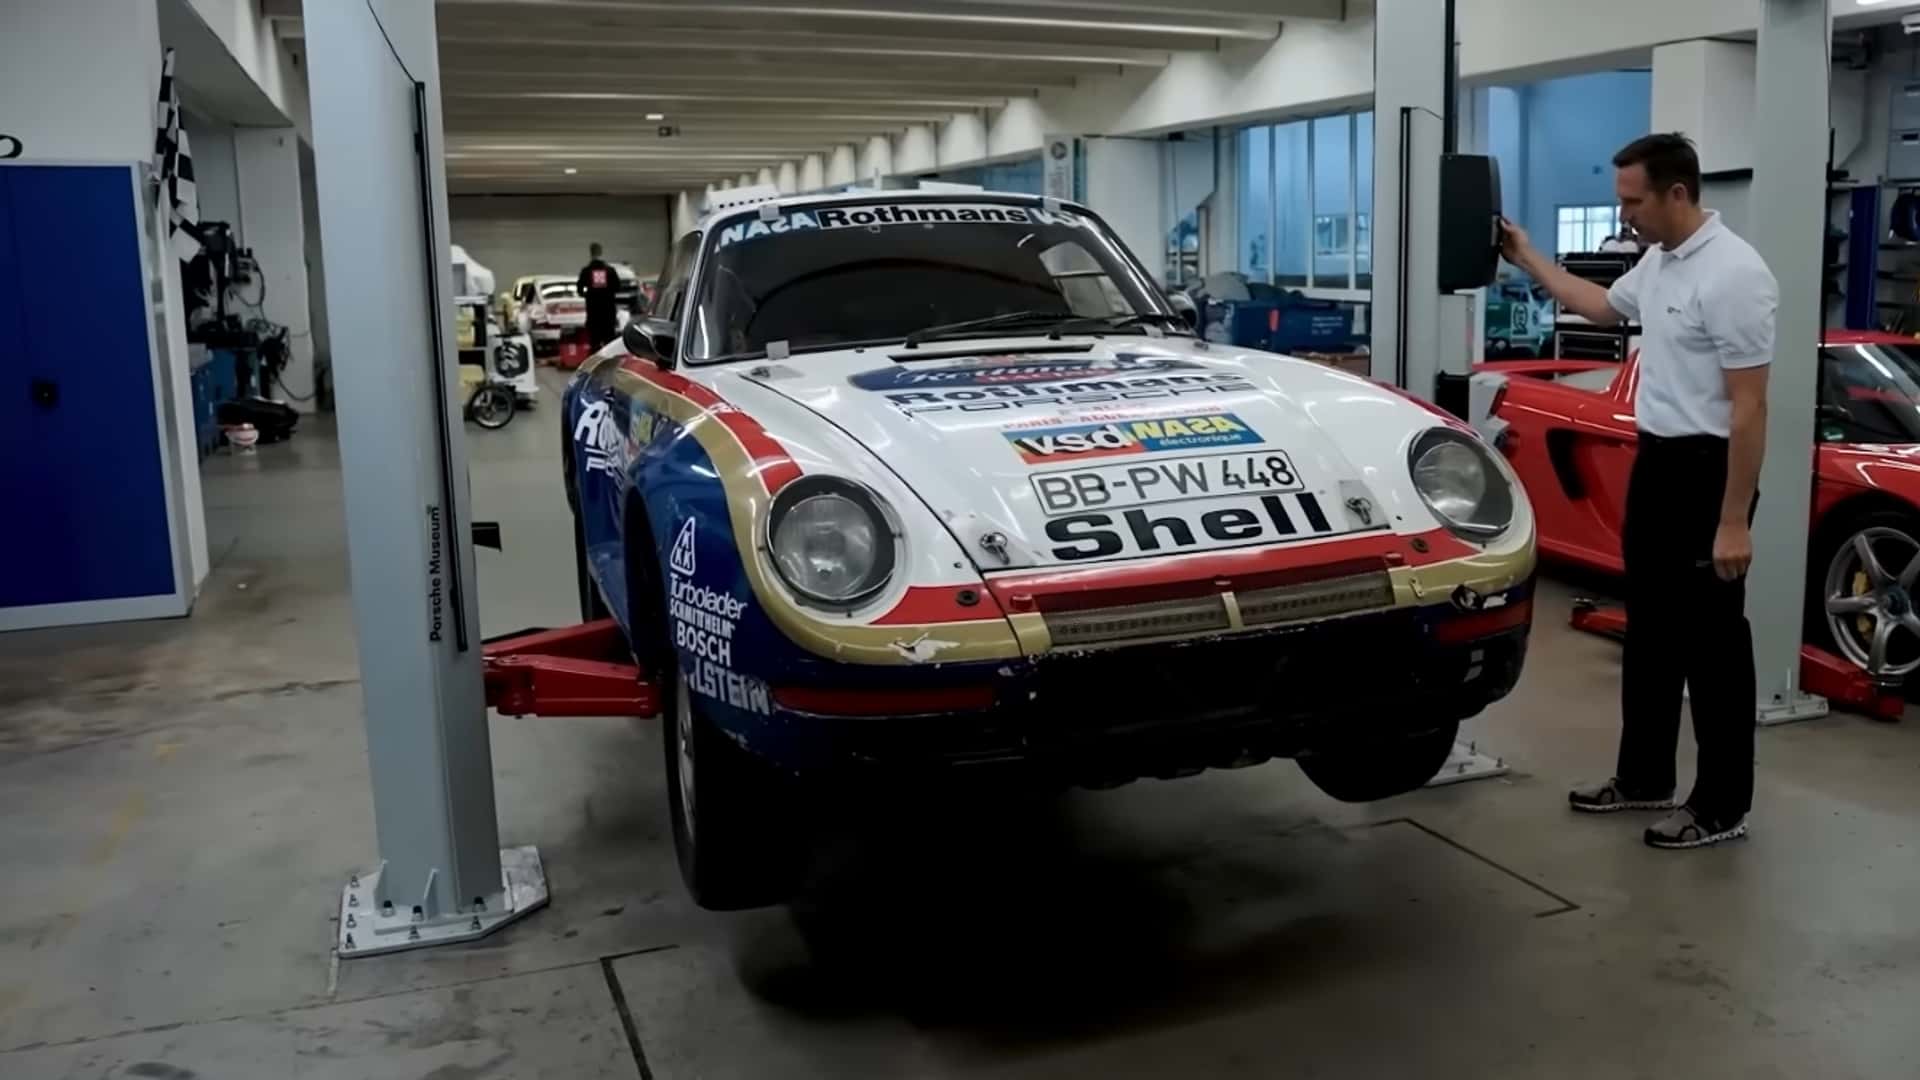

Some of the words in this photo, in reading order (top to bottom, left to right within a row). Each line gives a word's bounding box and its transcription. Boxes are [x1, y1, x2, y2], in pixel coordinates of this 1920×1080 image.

[819, 204, 1029, 229] Rothmans
[884, 373, 1245, 406] Rothmans
[898, 383, 1259, 416] PORSCHE
[1038, 461, 1208, 510] BB-PW
[1222, 456, 1295, 489] 448
[429, 506, 441, 575] Museum
[1045, 492, 1331, 561] Shell
[429, 577, 442, 642] Porsche
[669, 572, 748, 620] Turbolader
[676, 620, 731, 667] BOSCH
[688, 656, 771, 716] ILSTEIN
